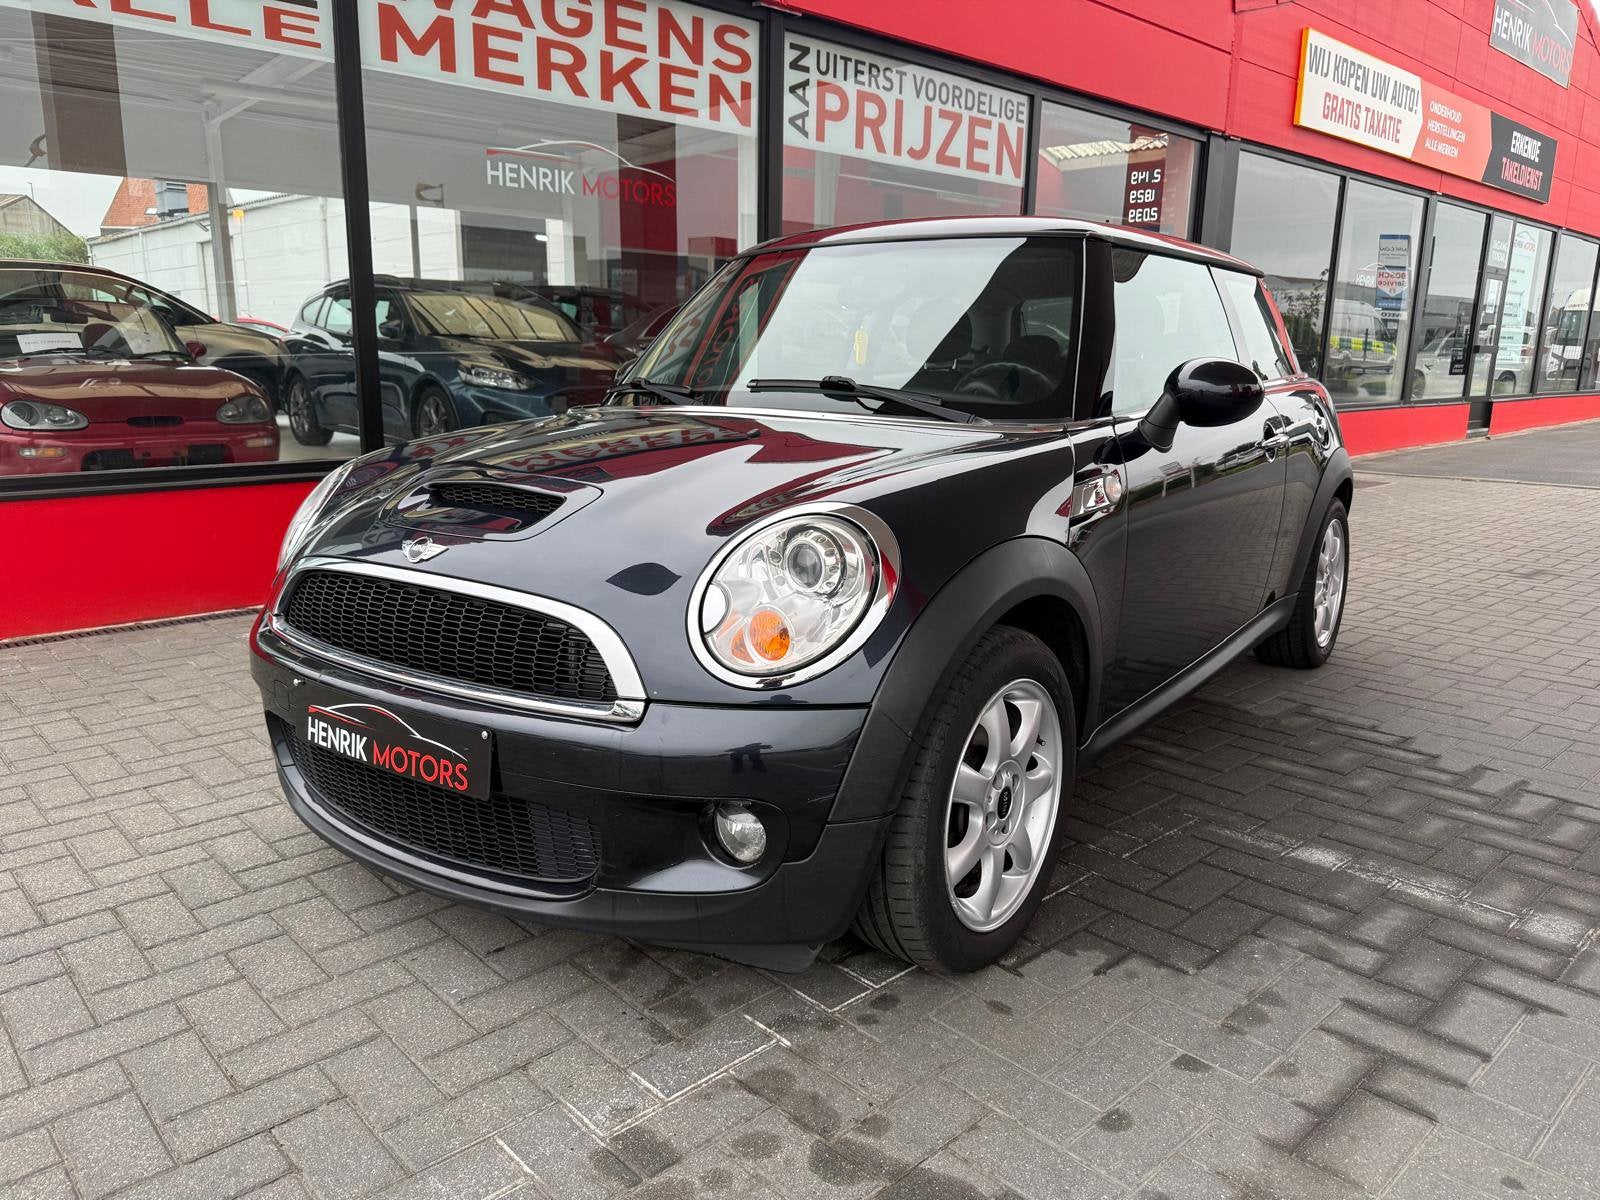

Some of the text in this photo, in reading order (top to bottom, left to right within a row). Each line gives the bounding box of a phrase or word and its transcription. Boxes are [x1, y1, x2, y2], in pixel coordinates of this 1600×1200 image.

[72, 0, 752, 128] LLE MERKEN
[433, 0, 752, 74] AGENS
[1493, 5, 1572, 76] HENRIK MOTORS
[788, 42, 811, 139] AAN
[816, 49, 1026, 124] UITERST VOORDELIGE
[1308, 43, 1420, 115] WIJ KOPEN UW AUTO!
[1429, 100, 1462, 124] ONDERHOUD
[815, 79, 1025, 180] PRIJZEN
[1322, 91, 1402, 144] GRATIS TAXATIE
[1510, 130, 1542, 163] ERKENDE
[486, 160, 676, 207] HENRIK MOTORS
[1501, 156, 1543, 192] TAKELDIENST
[307, 716, 469, 791] HENRIK MOTORS
